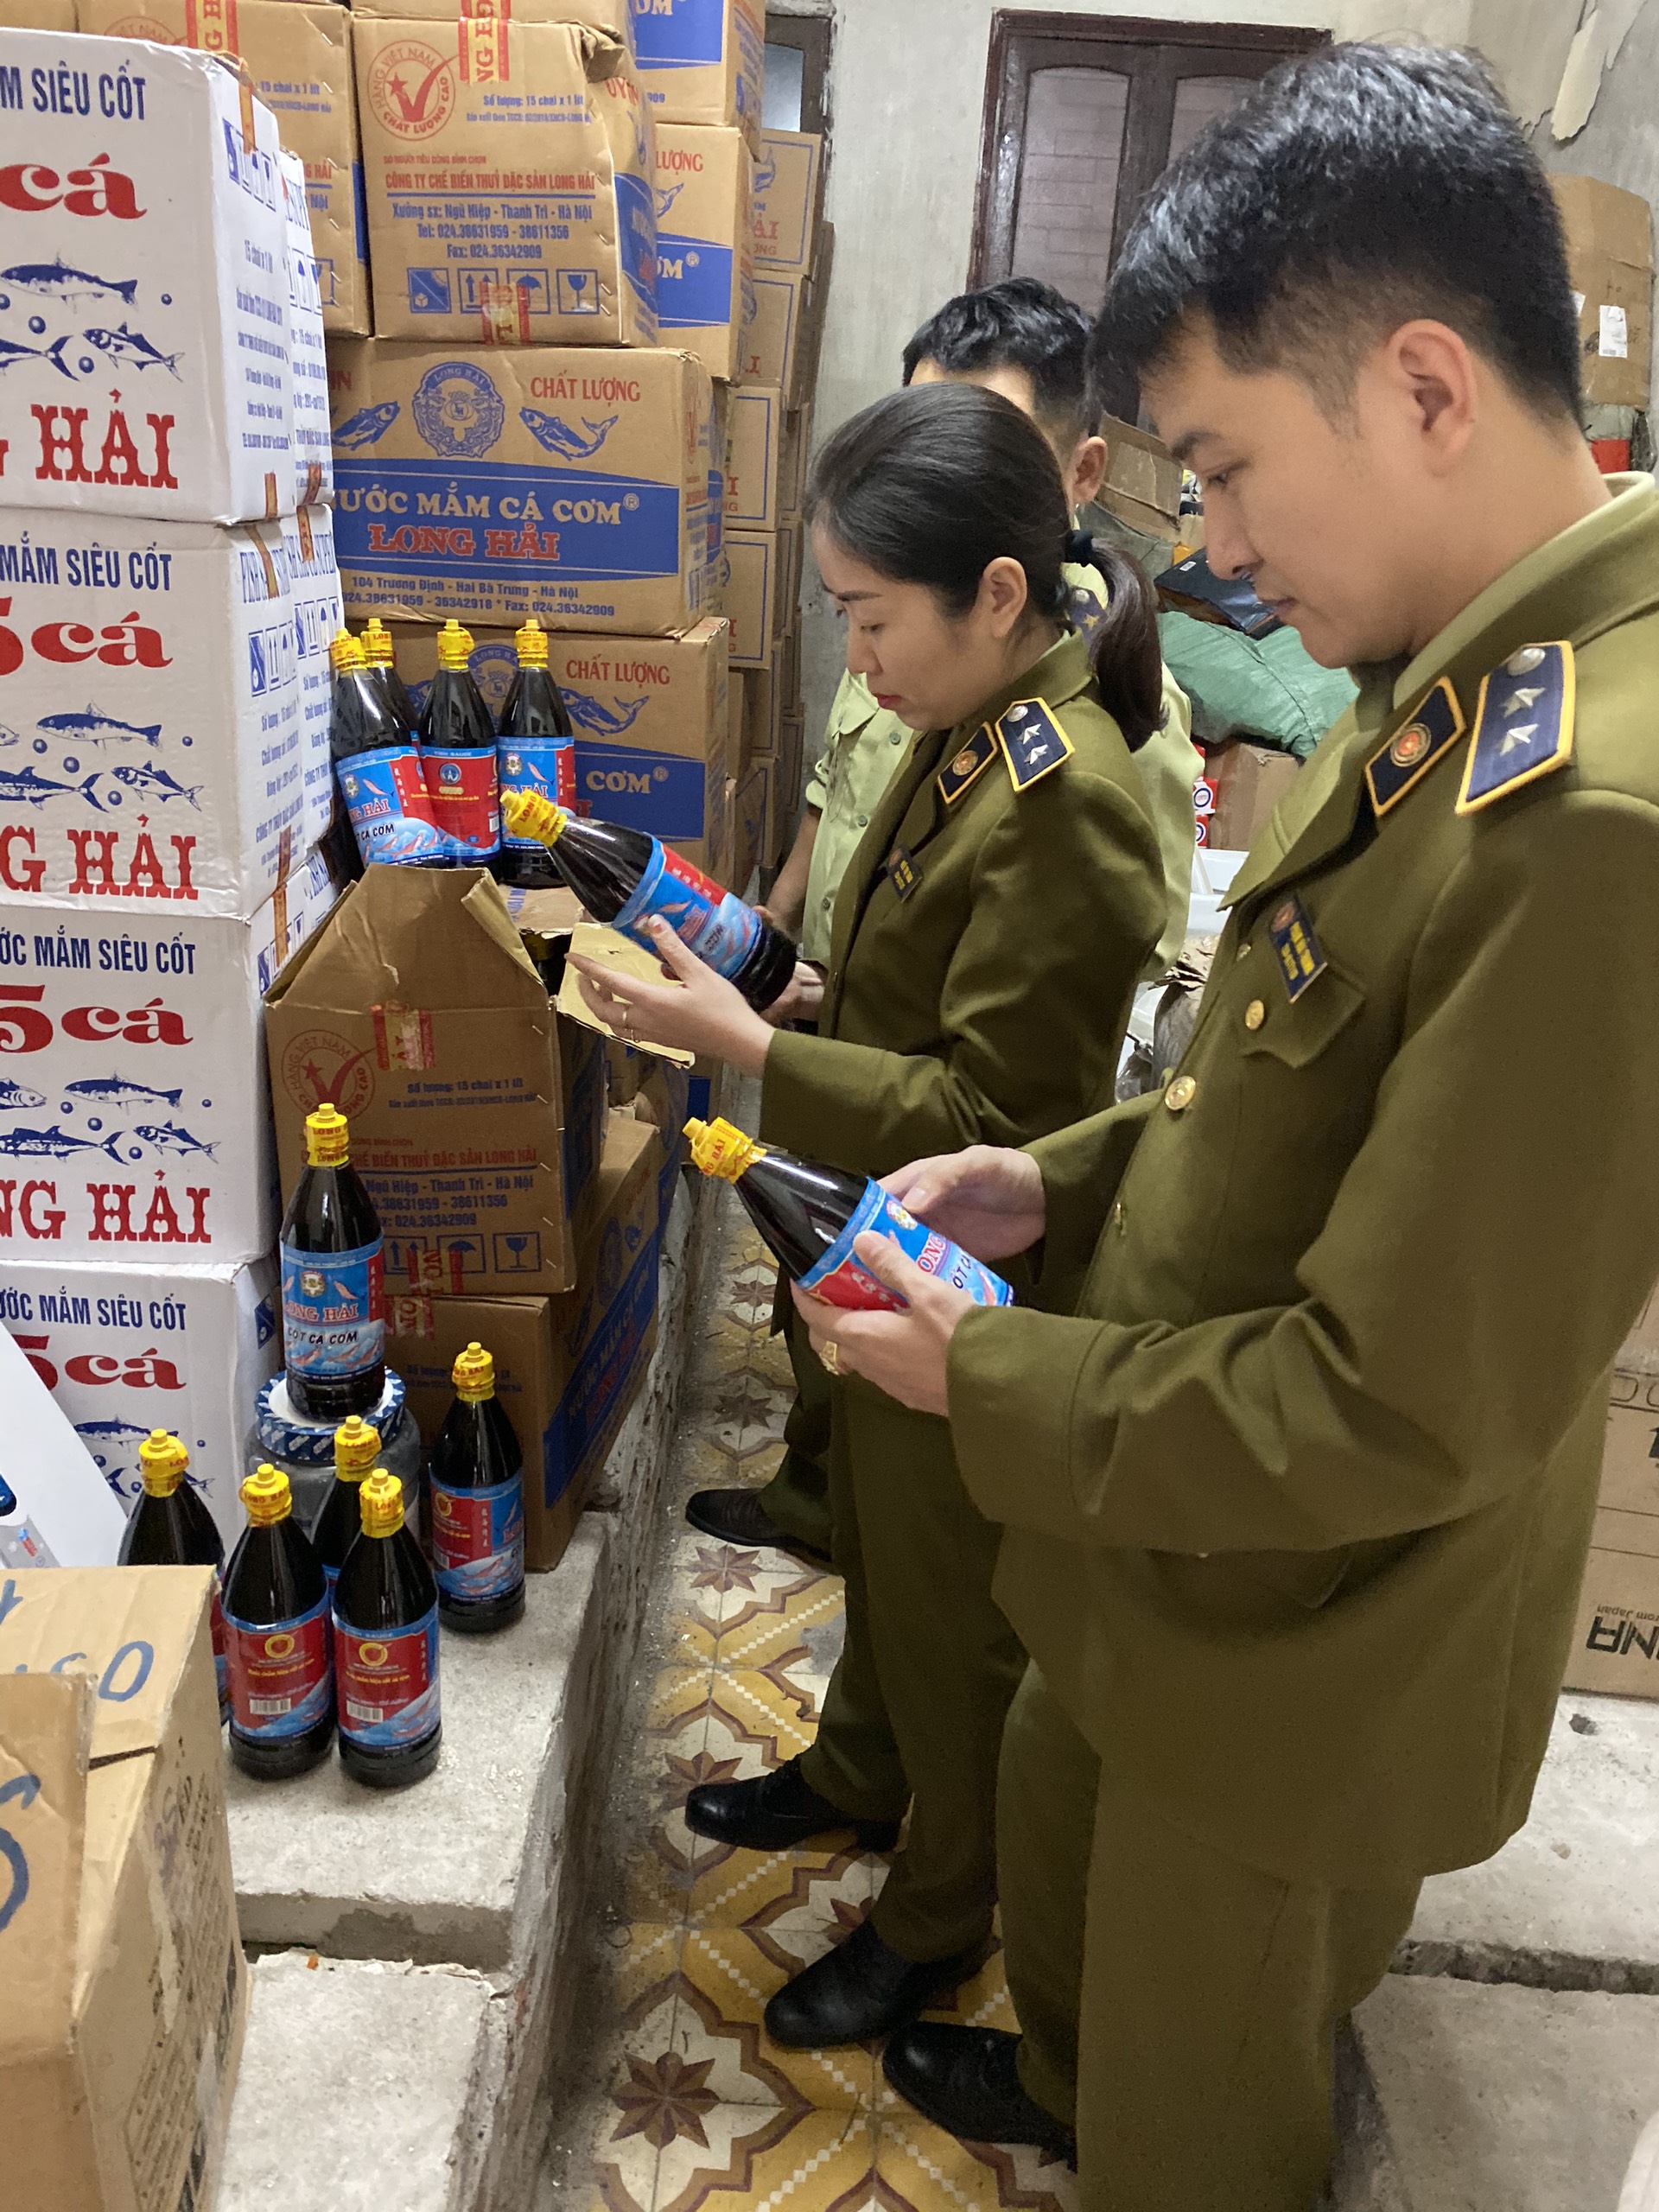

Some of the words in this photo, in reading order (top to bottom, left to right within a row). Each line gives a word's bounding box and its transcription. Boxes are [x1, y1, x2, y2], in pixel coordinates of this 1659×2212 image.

[32, 60, 91, 117] SIÊU
[99, 59, 146, 121] CỐT
[549, 175, 575, 190] LONG
[447, 244, 467, 258] Fax:
[530, 370, 577, 401] CHẤT
[582, 377, 641, 408] LƯỢNG
[30, 388, 179, 490] HẢI
[333, 483, 408, 514] ƯỚC
[417, 481, 490, 518] MẮM
[499, 490, 543, 522] CÁ
[553, 498, 621, 525] CƠM
[367, 524, 476, 557] LONG
[485, 522, 560, 562] HẢI
[67, 542, 121, 588] SIÊU
[129, 543, 172, 591] CỐT
[505, 599, 530, 613] Fax:
[566, 654, 610, 681] CHẤT
[615, 662, 671, 690] LƯỢNG
[586, 770, 651, 794] CƠM
[67, 813, 199, 900] HẢI
[34, 924, 92, 969] MẮM
[99, 932, 149, 973] SIÊU
[156, 931, 196, 975] CỐT
[86, 1169, 212, 1244] HẢI
[39, 1285, 91, 1325] MẮM
[98, 1294, 143, 1329] SIÊU
[149, 1294, 187, 1332] CỐT
[323, 1302, 359, 1322] HẢI
